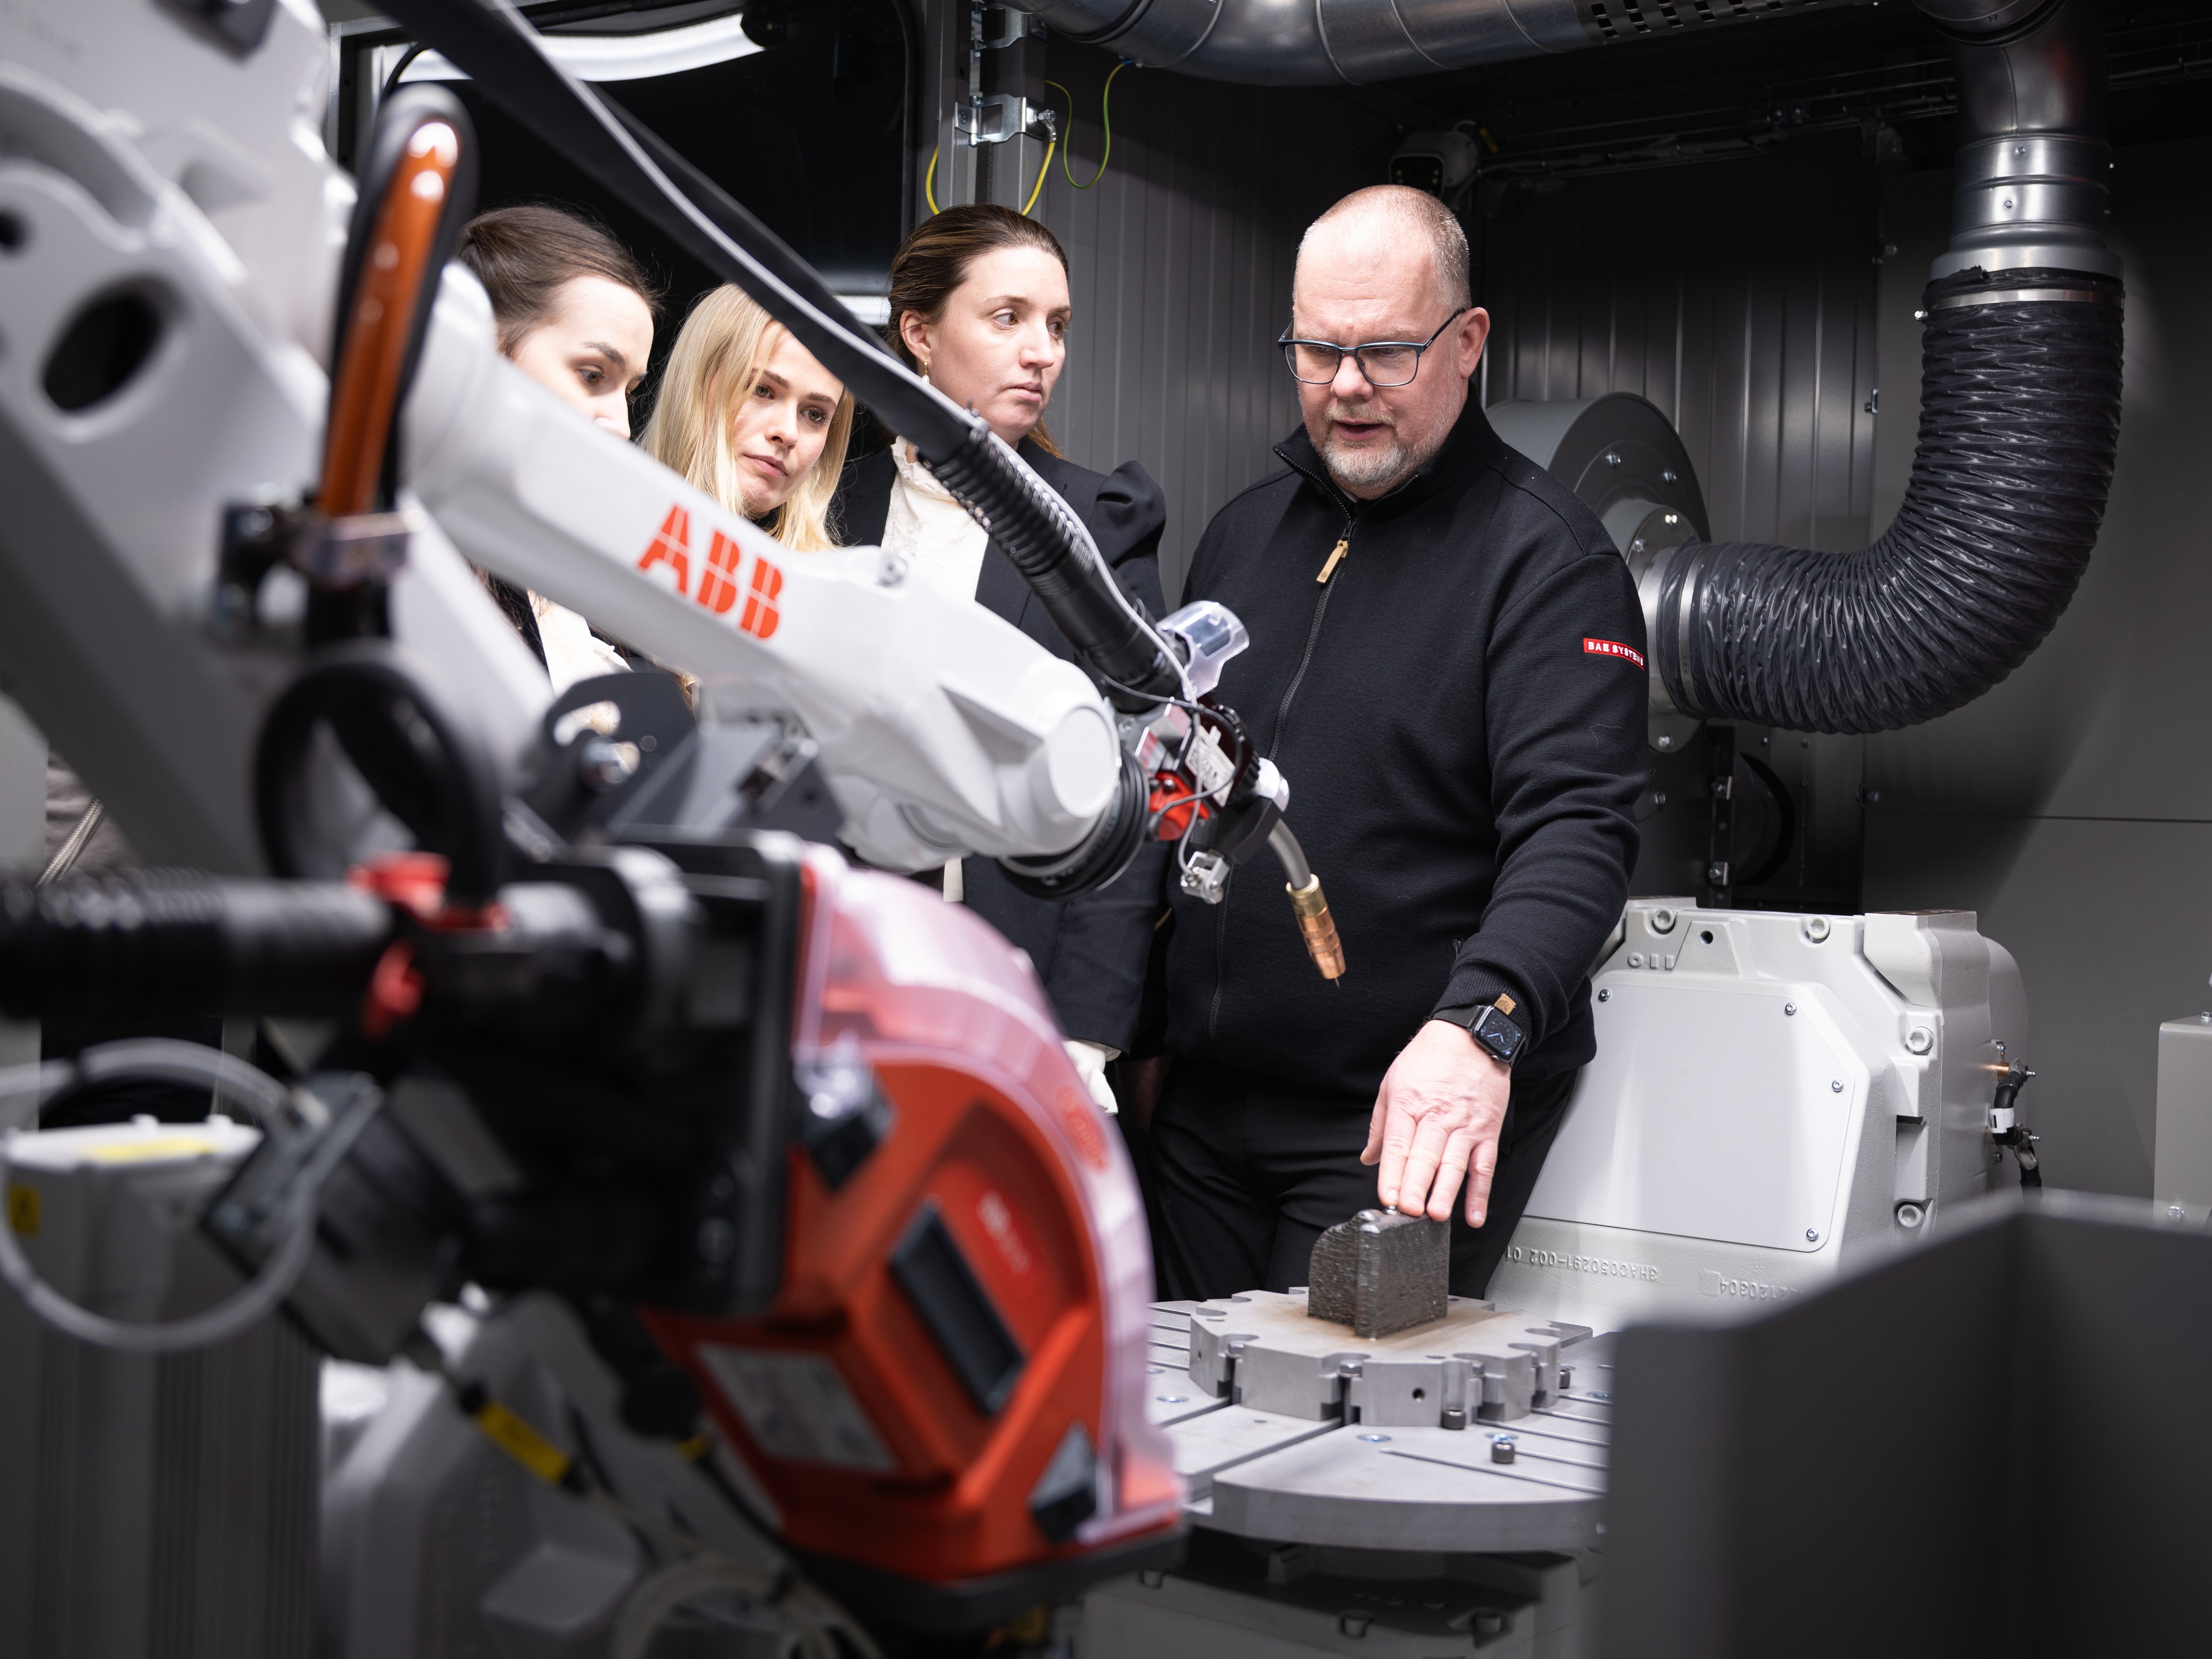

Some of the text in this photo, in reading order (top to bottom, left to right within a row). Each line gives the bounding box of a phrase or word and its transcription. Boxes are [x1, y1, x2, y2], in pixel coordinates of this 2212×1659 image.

[638, 503, 783, 639] ABB
[1588, 641, 1643, 666] BAE SYSTEMS
[1506, 1246, 1522, 1262] 01
